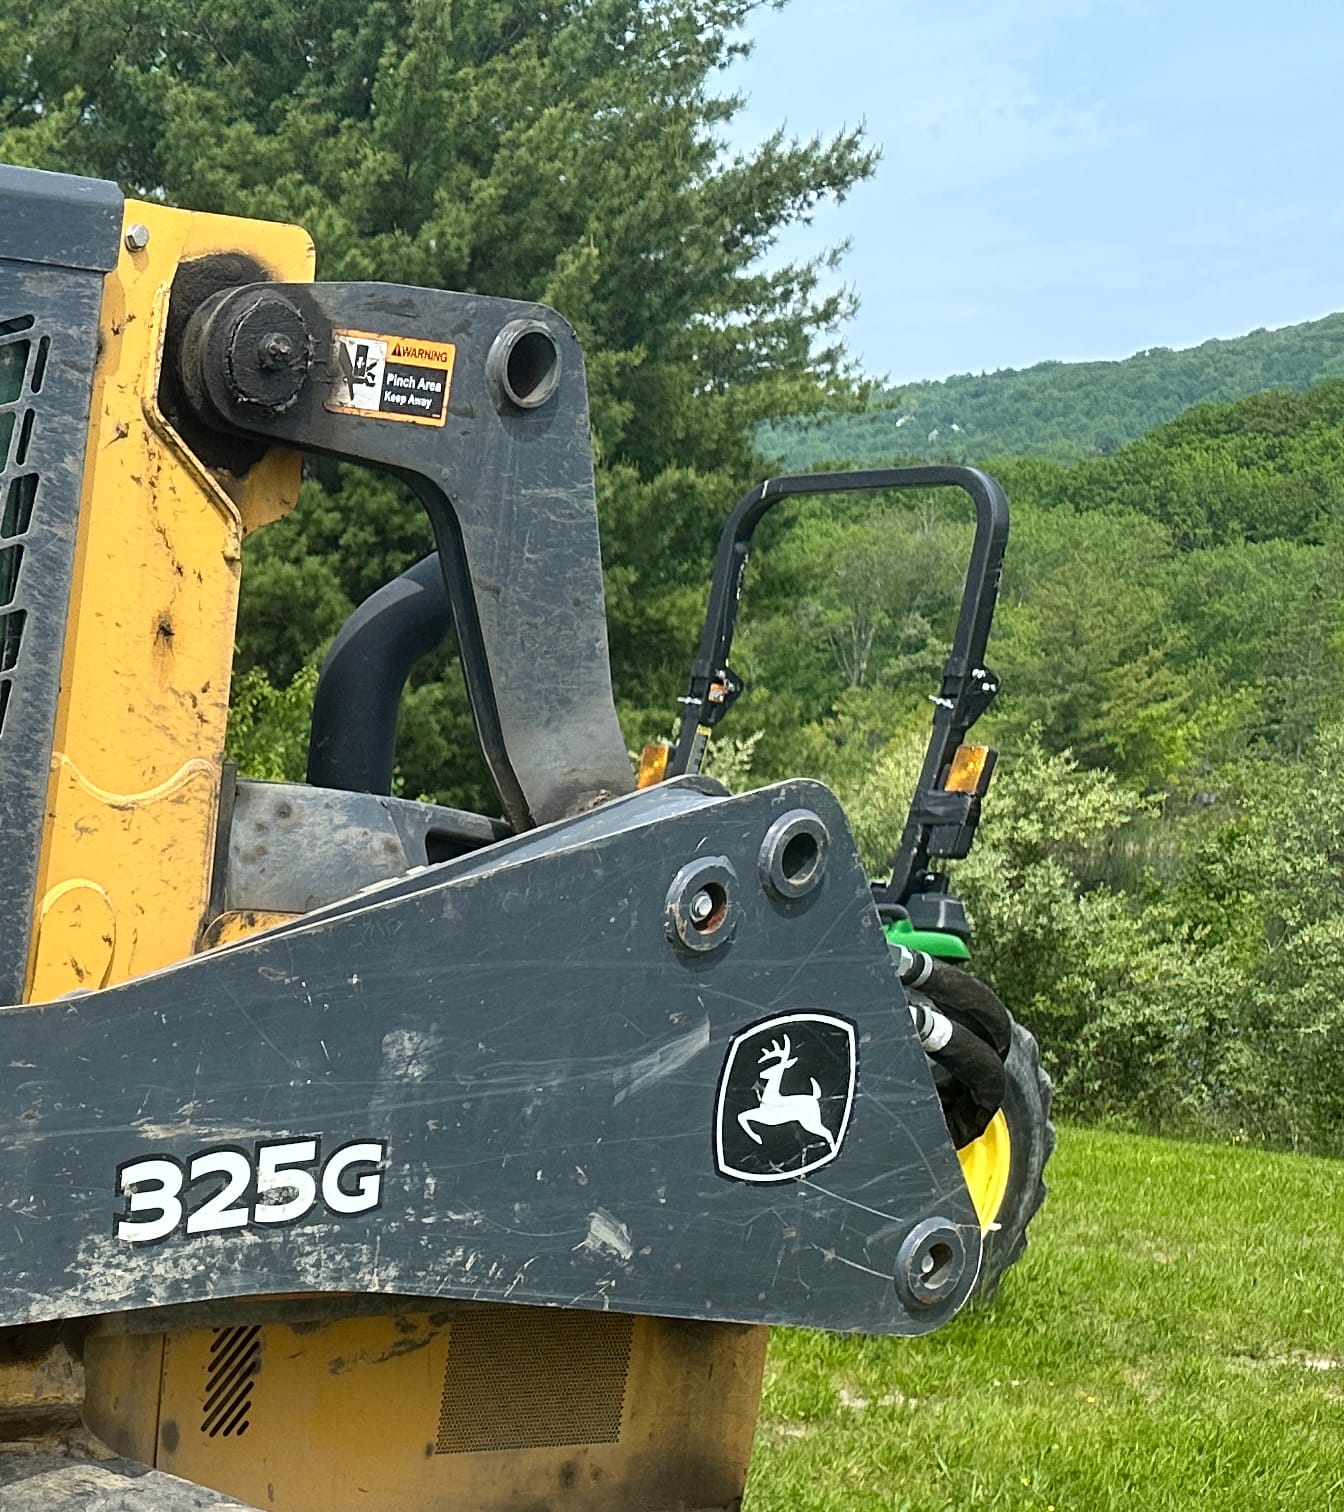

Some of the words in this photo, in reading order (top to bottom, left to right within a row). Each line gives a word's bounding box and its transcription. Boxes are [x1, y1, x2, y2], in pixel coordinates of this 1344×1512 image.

[402, 345, 448, 363] WARNING
[386, 372, 416, 390] Pinch
[417, 377, 442, 393] Area
[384, 390, 407, 406] Keep
[408, 393, 433, 410] Away
[118, 1140, 383, 1242] 325G
